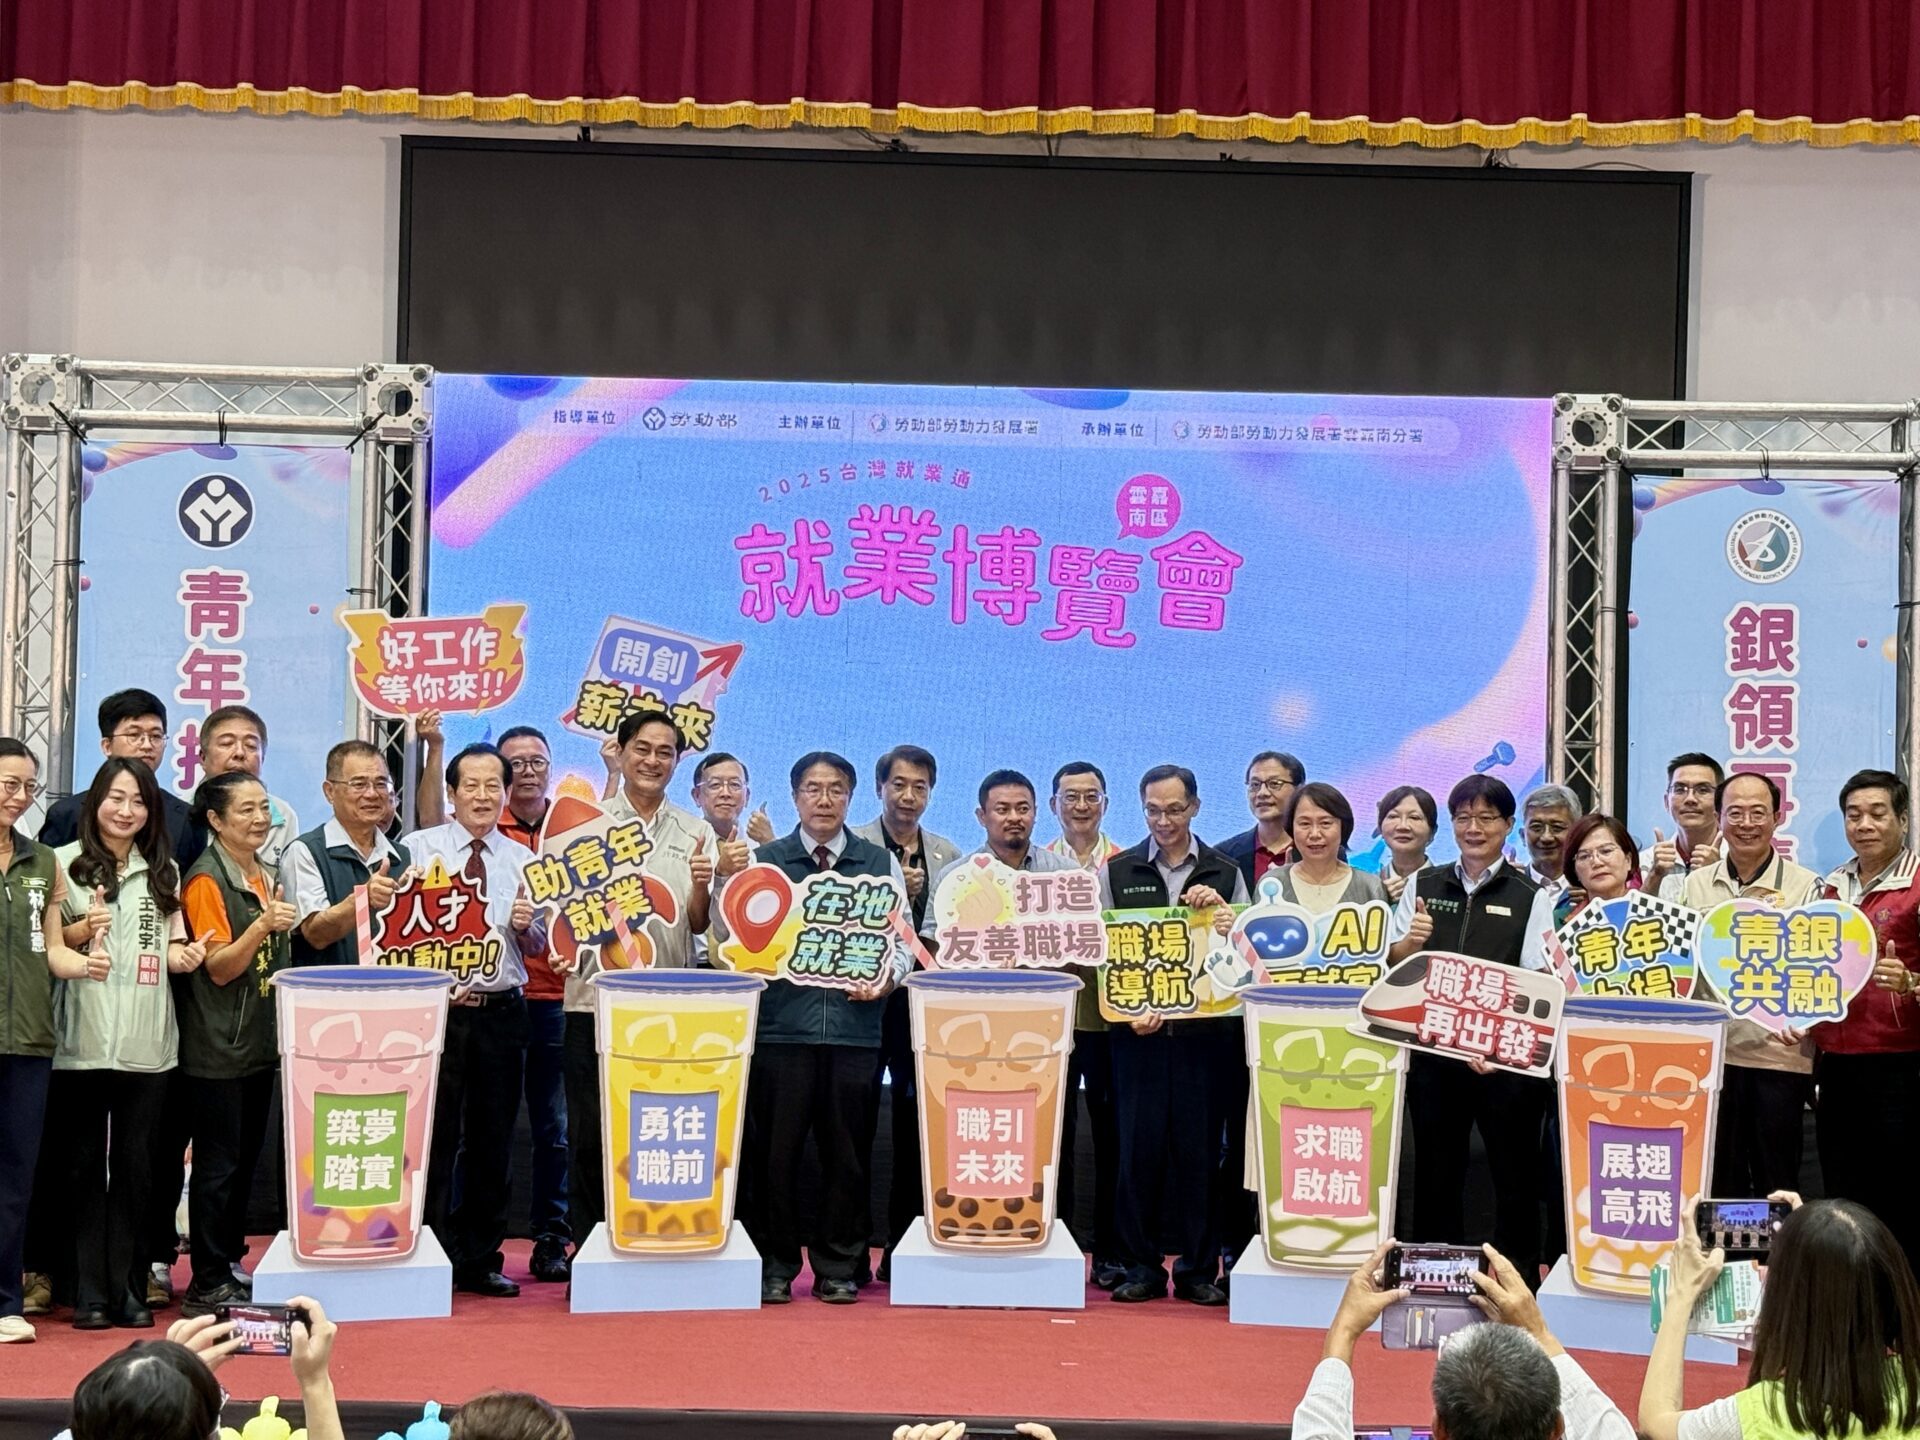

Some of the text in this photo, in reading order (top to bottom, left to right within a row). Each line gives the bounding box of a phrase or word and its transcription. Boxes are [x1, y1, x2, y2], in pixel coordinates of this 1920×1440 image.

[552, 409, 616, 425] 指導單位
[669, 411, 738, 429] 勞動部
[777, 414, 842, 430] 主辦單位
[1080, 421, 1145, 438] 承辦單位
[757, 458, 972, 503] 2025台灣就業通
[1128, 507, 1169, 528] 南區
[733, 502, 1245, 649] 就業博覽會
[380, 626, 499, 671] 好工作
[612, 637, 690, 687] 開創
[376, 671, 504, 706] 等你來!!
[1728, 606, 1795, 861] 銀領
[525, 822, 652, 902] 助青年
[401, 888, 470, 936] 人才
[564, 875, 653, 943] 就業
[802, 876, 898, 927] 在地
[1015, 876, 1096, 914] 打造
[138, 895, 155, 950] 王定宇
[941, 922, 1104, 963] 友善職場
[1106, 922, 1189, 965] 職場
[1324, 908, 1385, 955] AI
[1733, 911, 1843, 962] 青銀
[791, 928, 886, 979] 就業
[1577, 920, 1667, 974] 青年
[1108, 966, 1193, 1007] 導航
[1426, 957, 1505, 1010] 職場
[1733, 965, 1841, 1016] 共融
[1418, 1001, 1537, 1068] 再出發
[325, 1107, 397, 1148] 築夢
[637, 1105, 707, 1143] 勇往
[955, 1107, 1025, 1144] 職引
[1292, 1122, 1365, 1164] 求職
[323, 1152, 396, 1193] 踏實
[635, 1149, 705, 1187] 職前
[955, 1149, 1026, 1186] 未來
[1600, 1142, 1672, 1182] 展翅
[1601, 1187, 1673, 1228] 高飛
